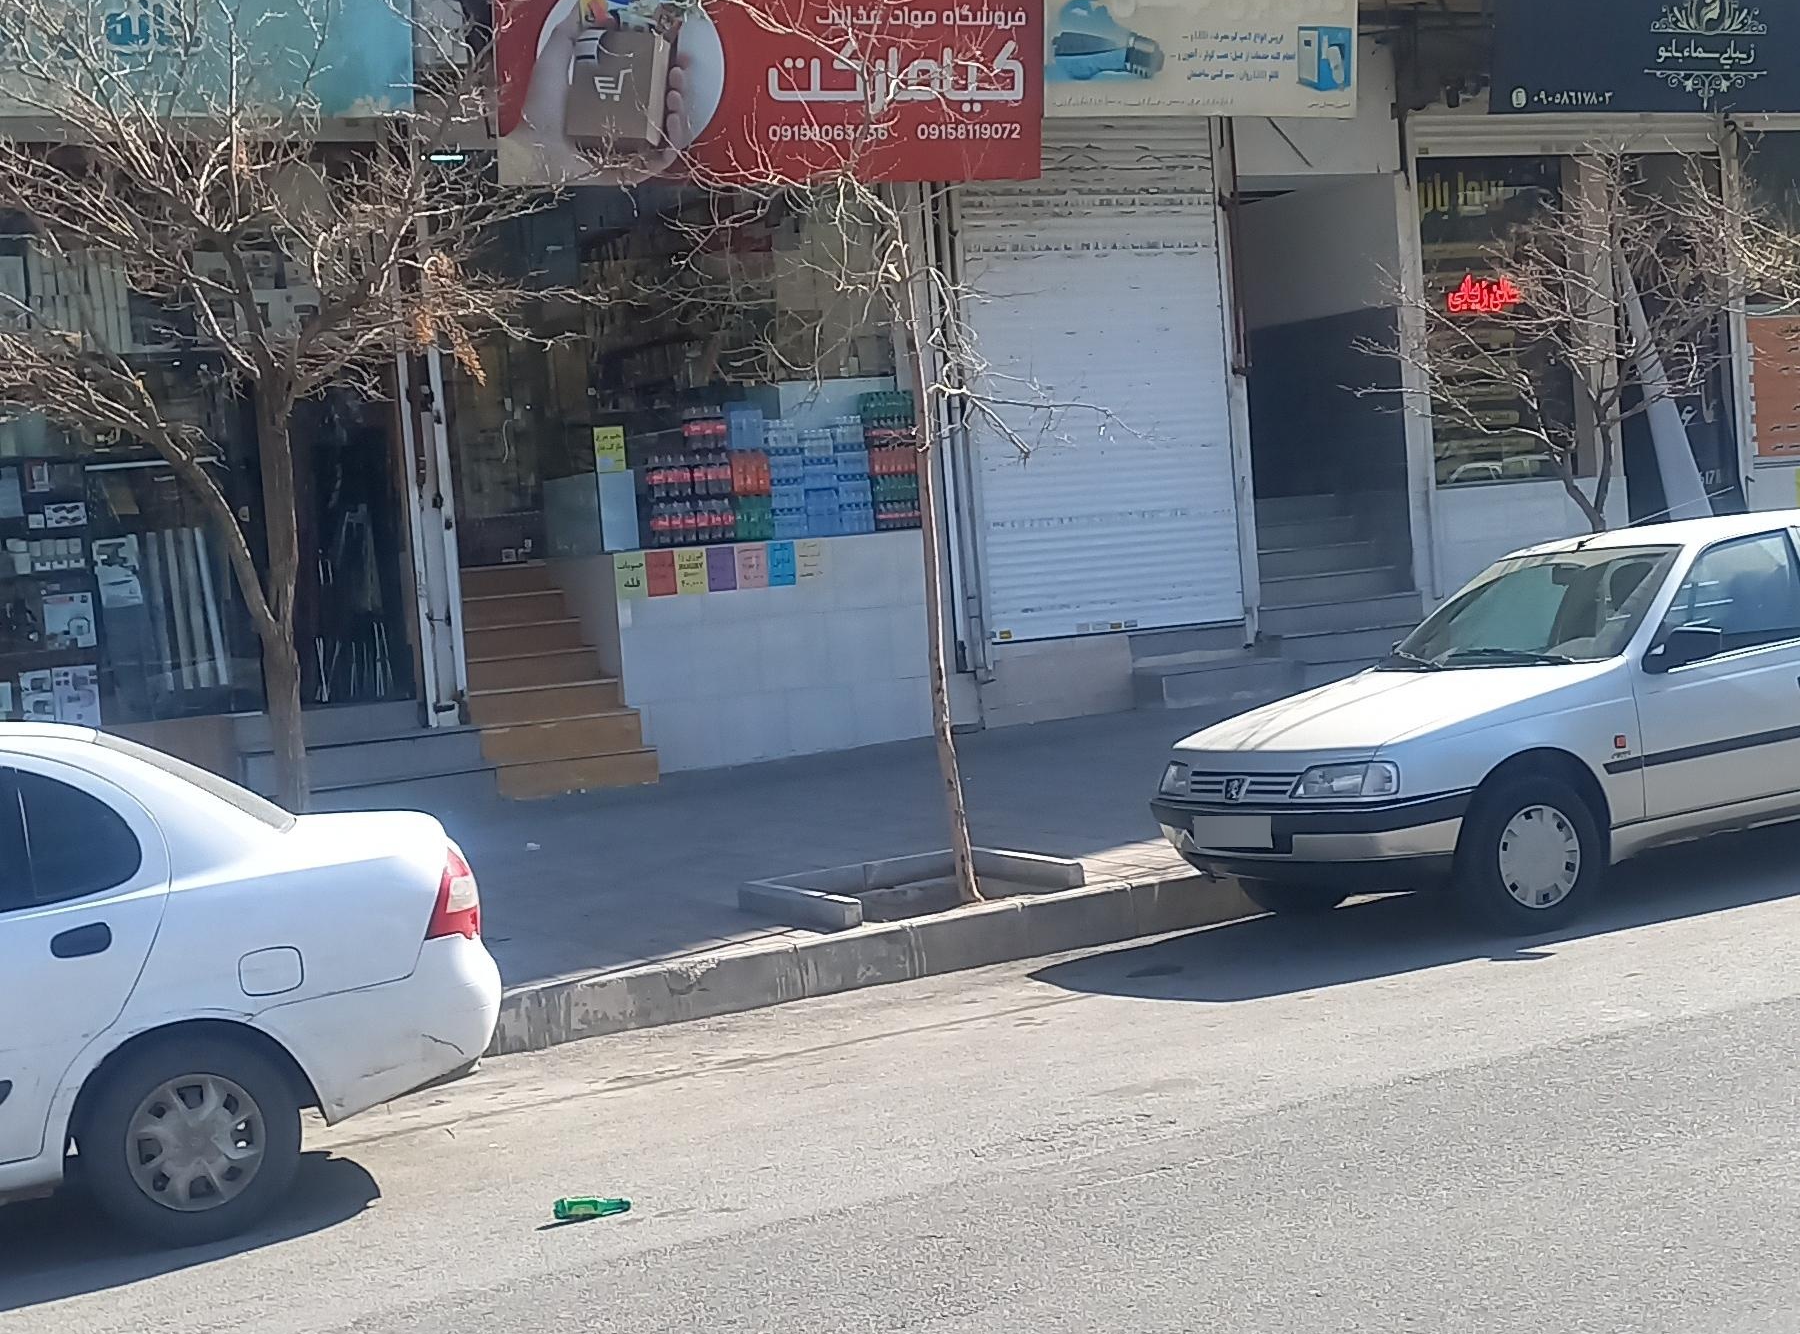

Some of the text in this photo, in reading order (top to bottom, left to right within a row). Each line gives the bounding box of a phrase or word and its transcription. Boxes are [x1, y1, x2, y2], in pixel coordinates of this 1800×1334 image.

[888, 6, 937, 28] مواد
[942, 4, 1026, 29] فروشگاه
[1656, 38, 1683, 62] بانو
[916, 123, 1021, 139] 09158119072
